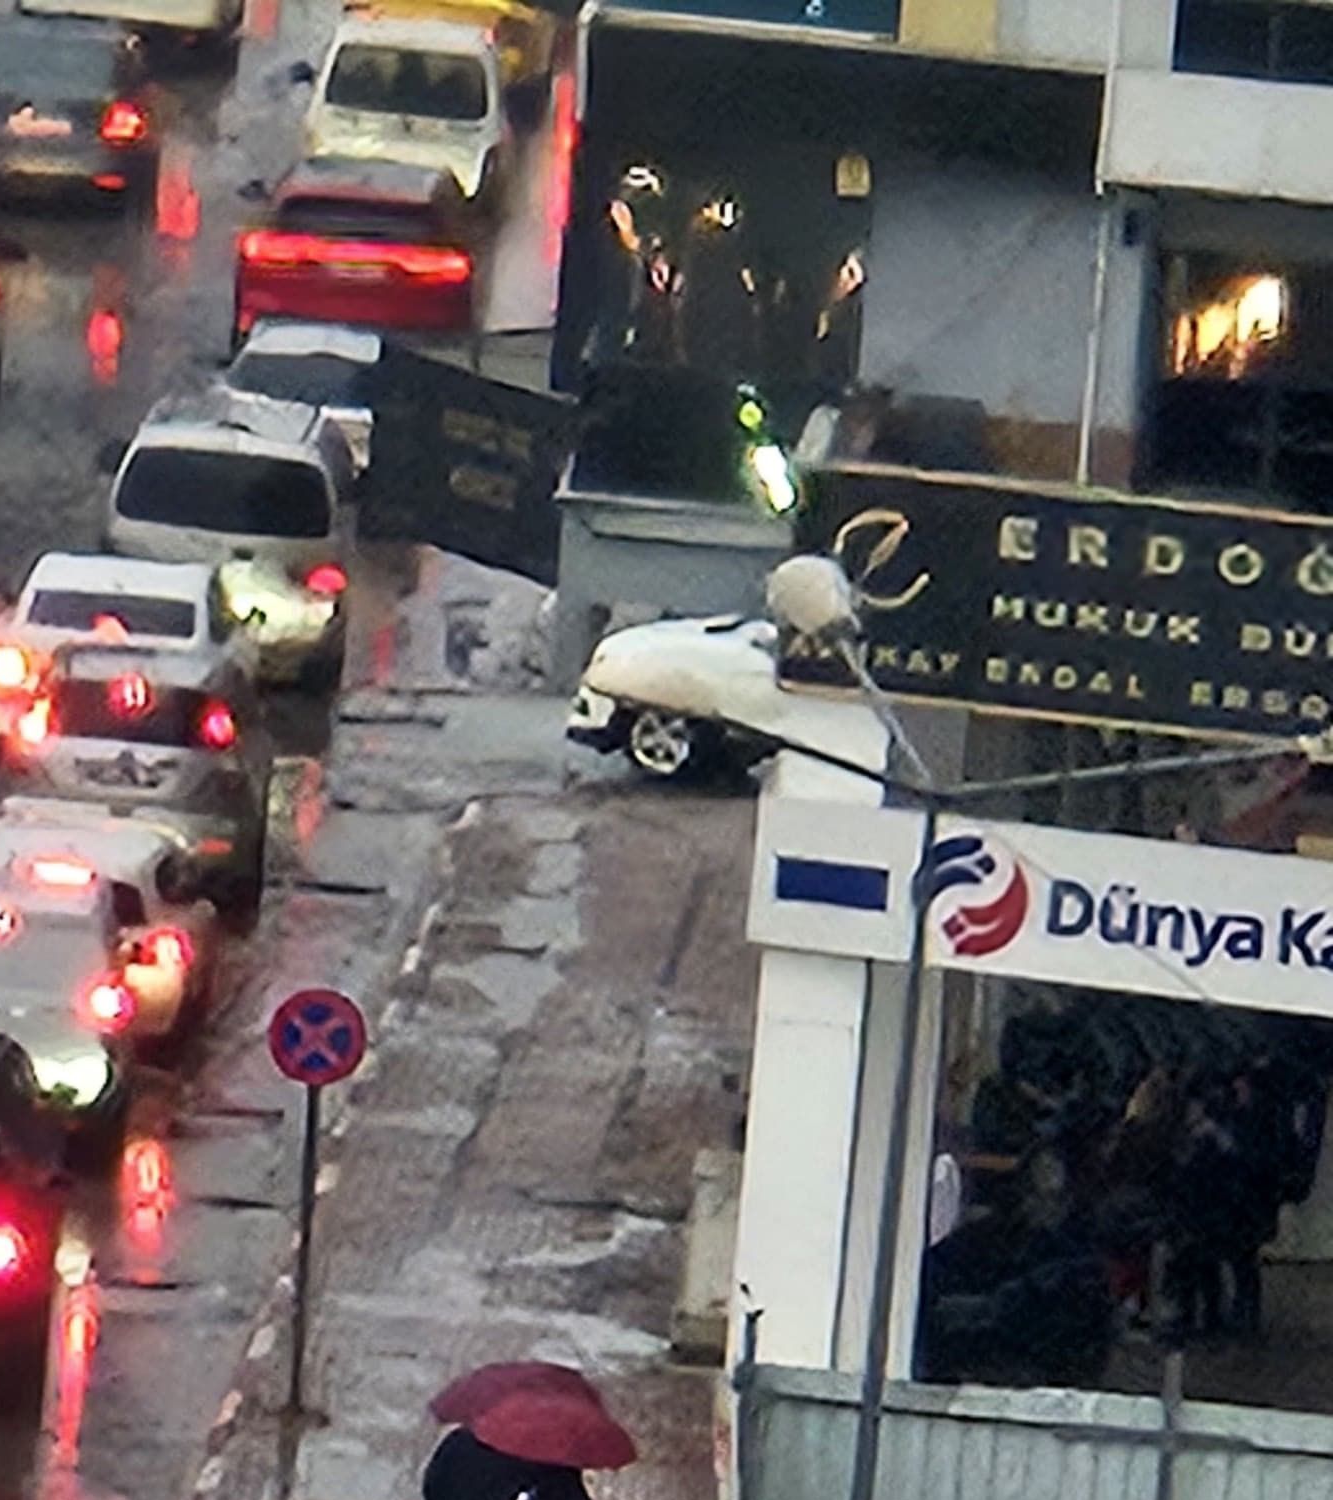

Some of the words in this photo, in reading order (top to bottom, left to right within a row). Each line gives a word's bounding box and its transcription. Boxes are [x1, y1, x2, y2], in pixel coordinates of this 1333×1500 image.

[991, 594, 1201, 644] HUKUK
[985, 656, 1145, 699] ERDAL
[1044, 878, 1264, 967] Dünya
